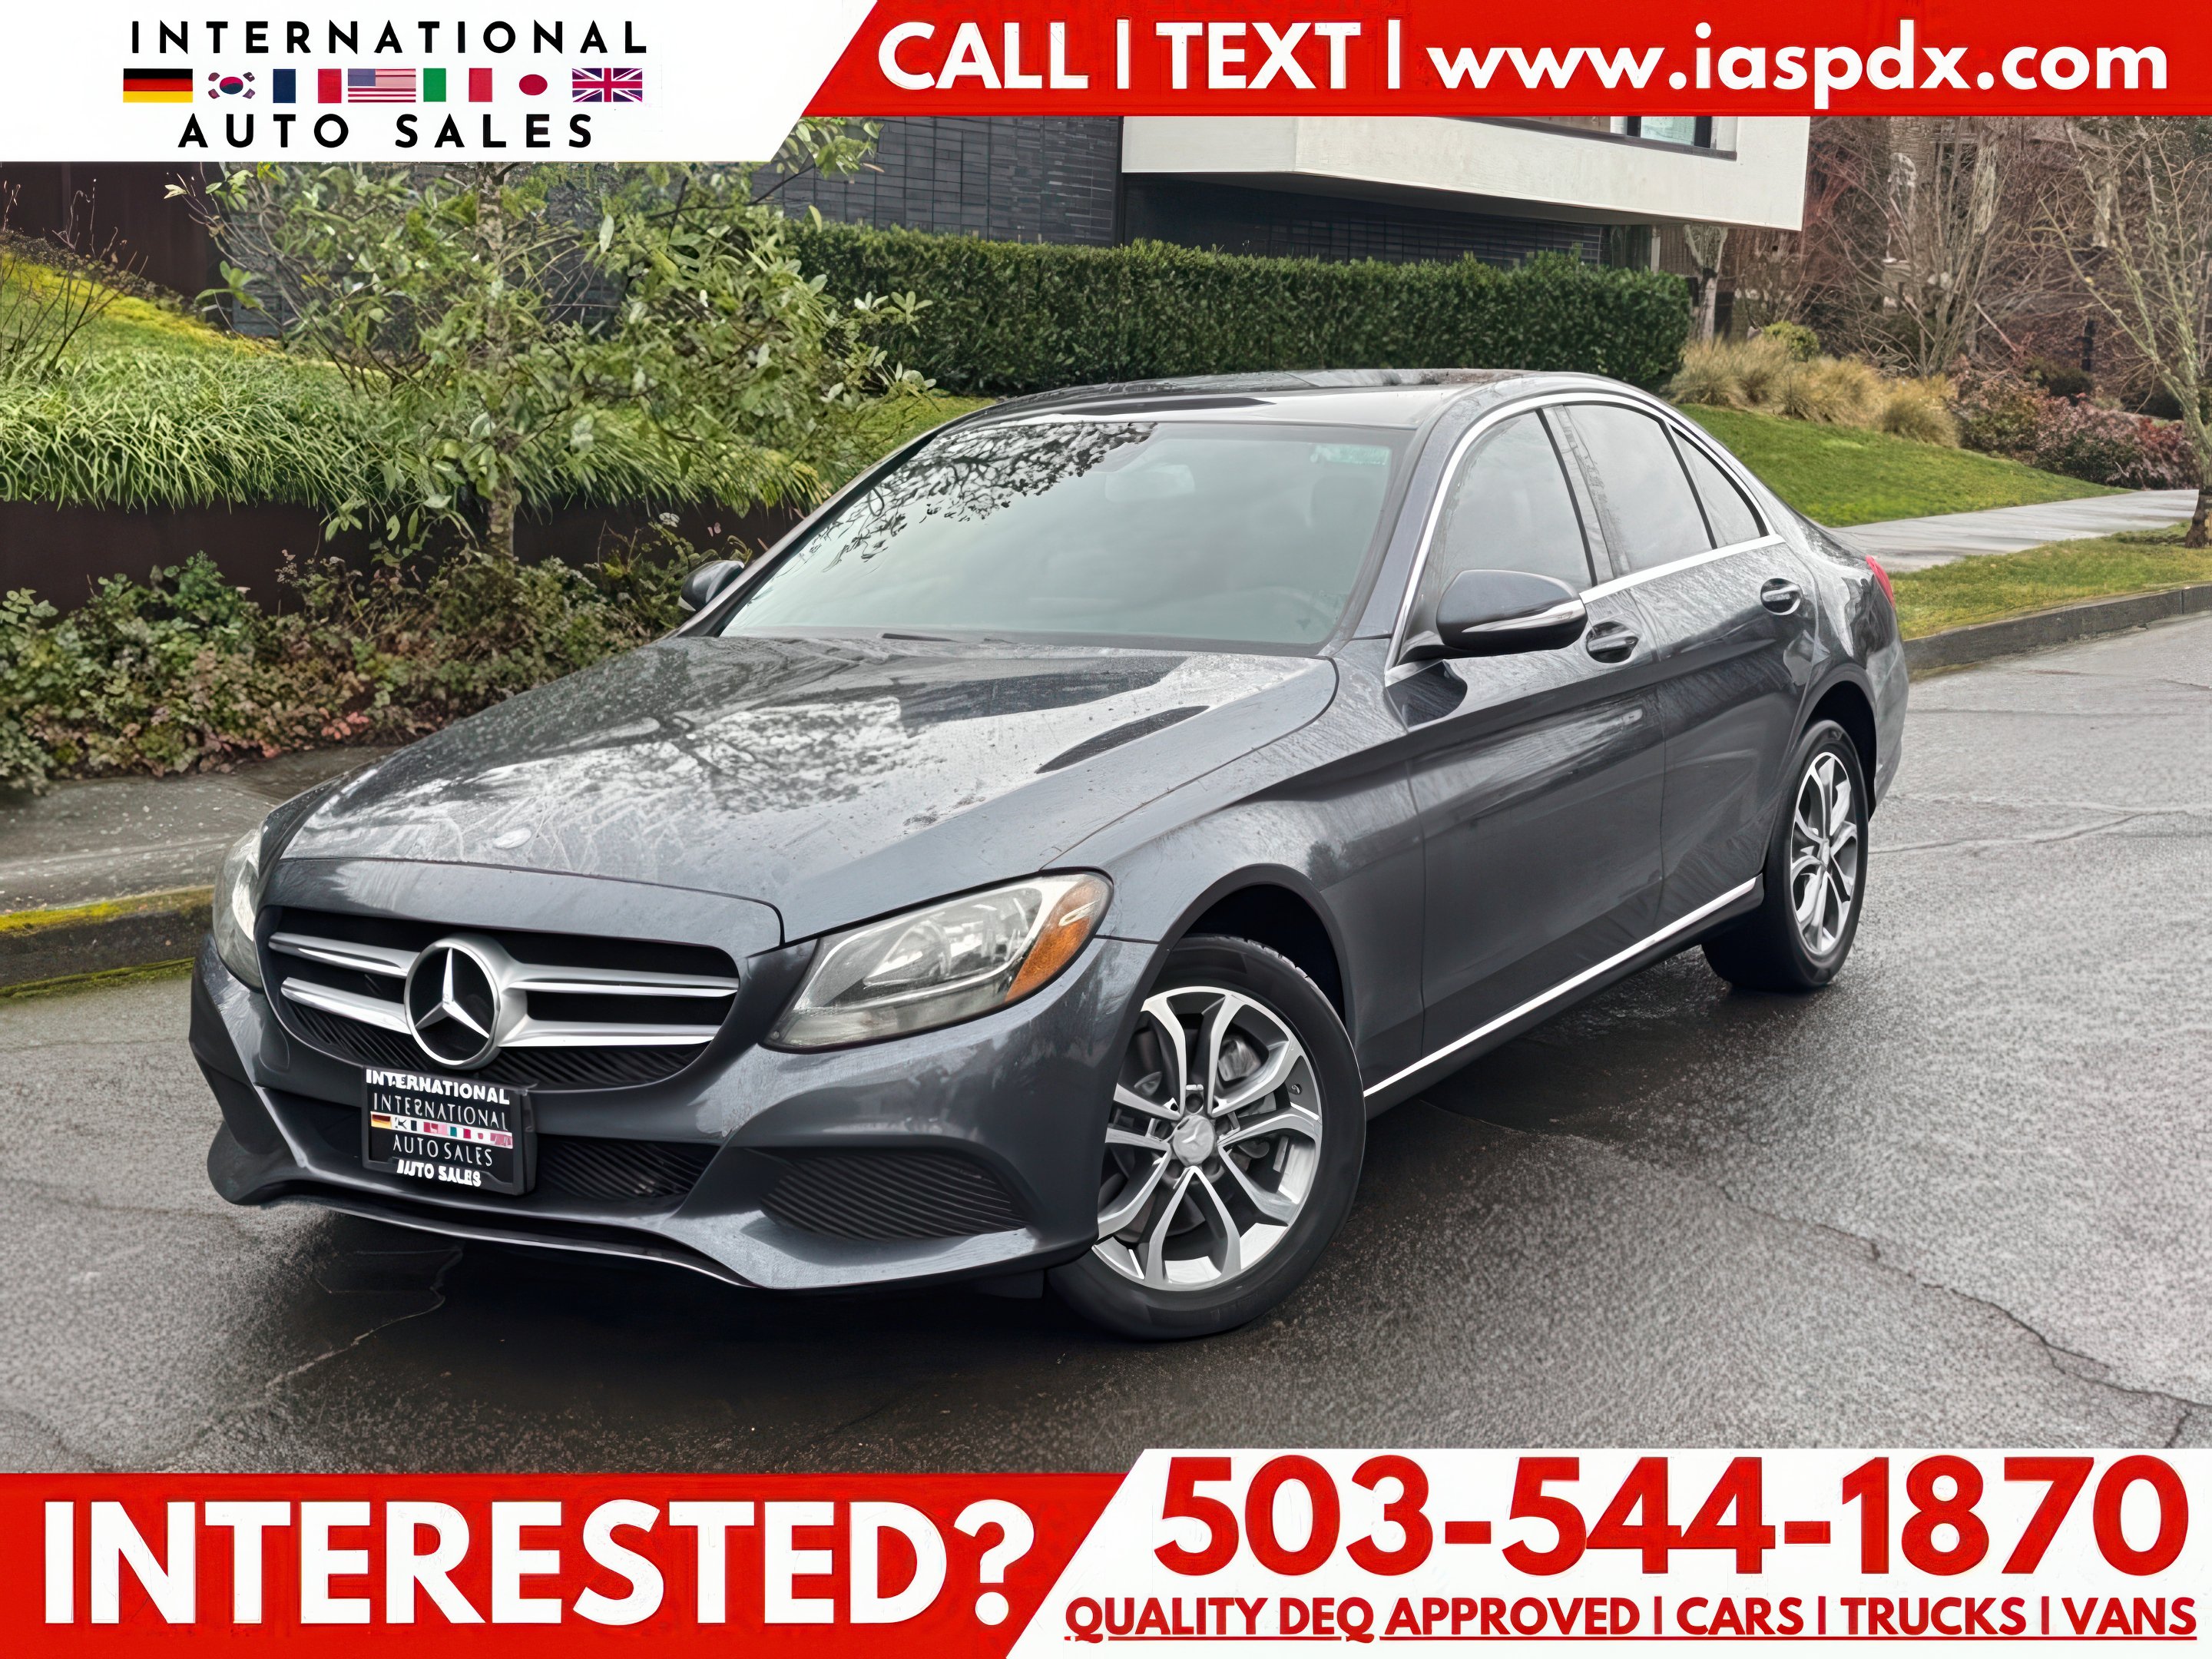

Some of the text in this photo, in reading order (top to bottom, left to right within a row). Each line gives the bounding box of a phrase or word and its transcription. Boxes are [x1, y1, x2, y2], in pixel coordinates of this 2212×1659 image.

[366, 1068, 510, 1105] INTERNATIONAL
[373, 1092, 508, 1131] INTERNATIONAL
[392, 1134, 493, 1167] AUTO SALES
[438, 1165, 482, 1187] SALES
